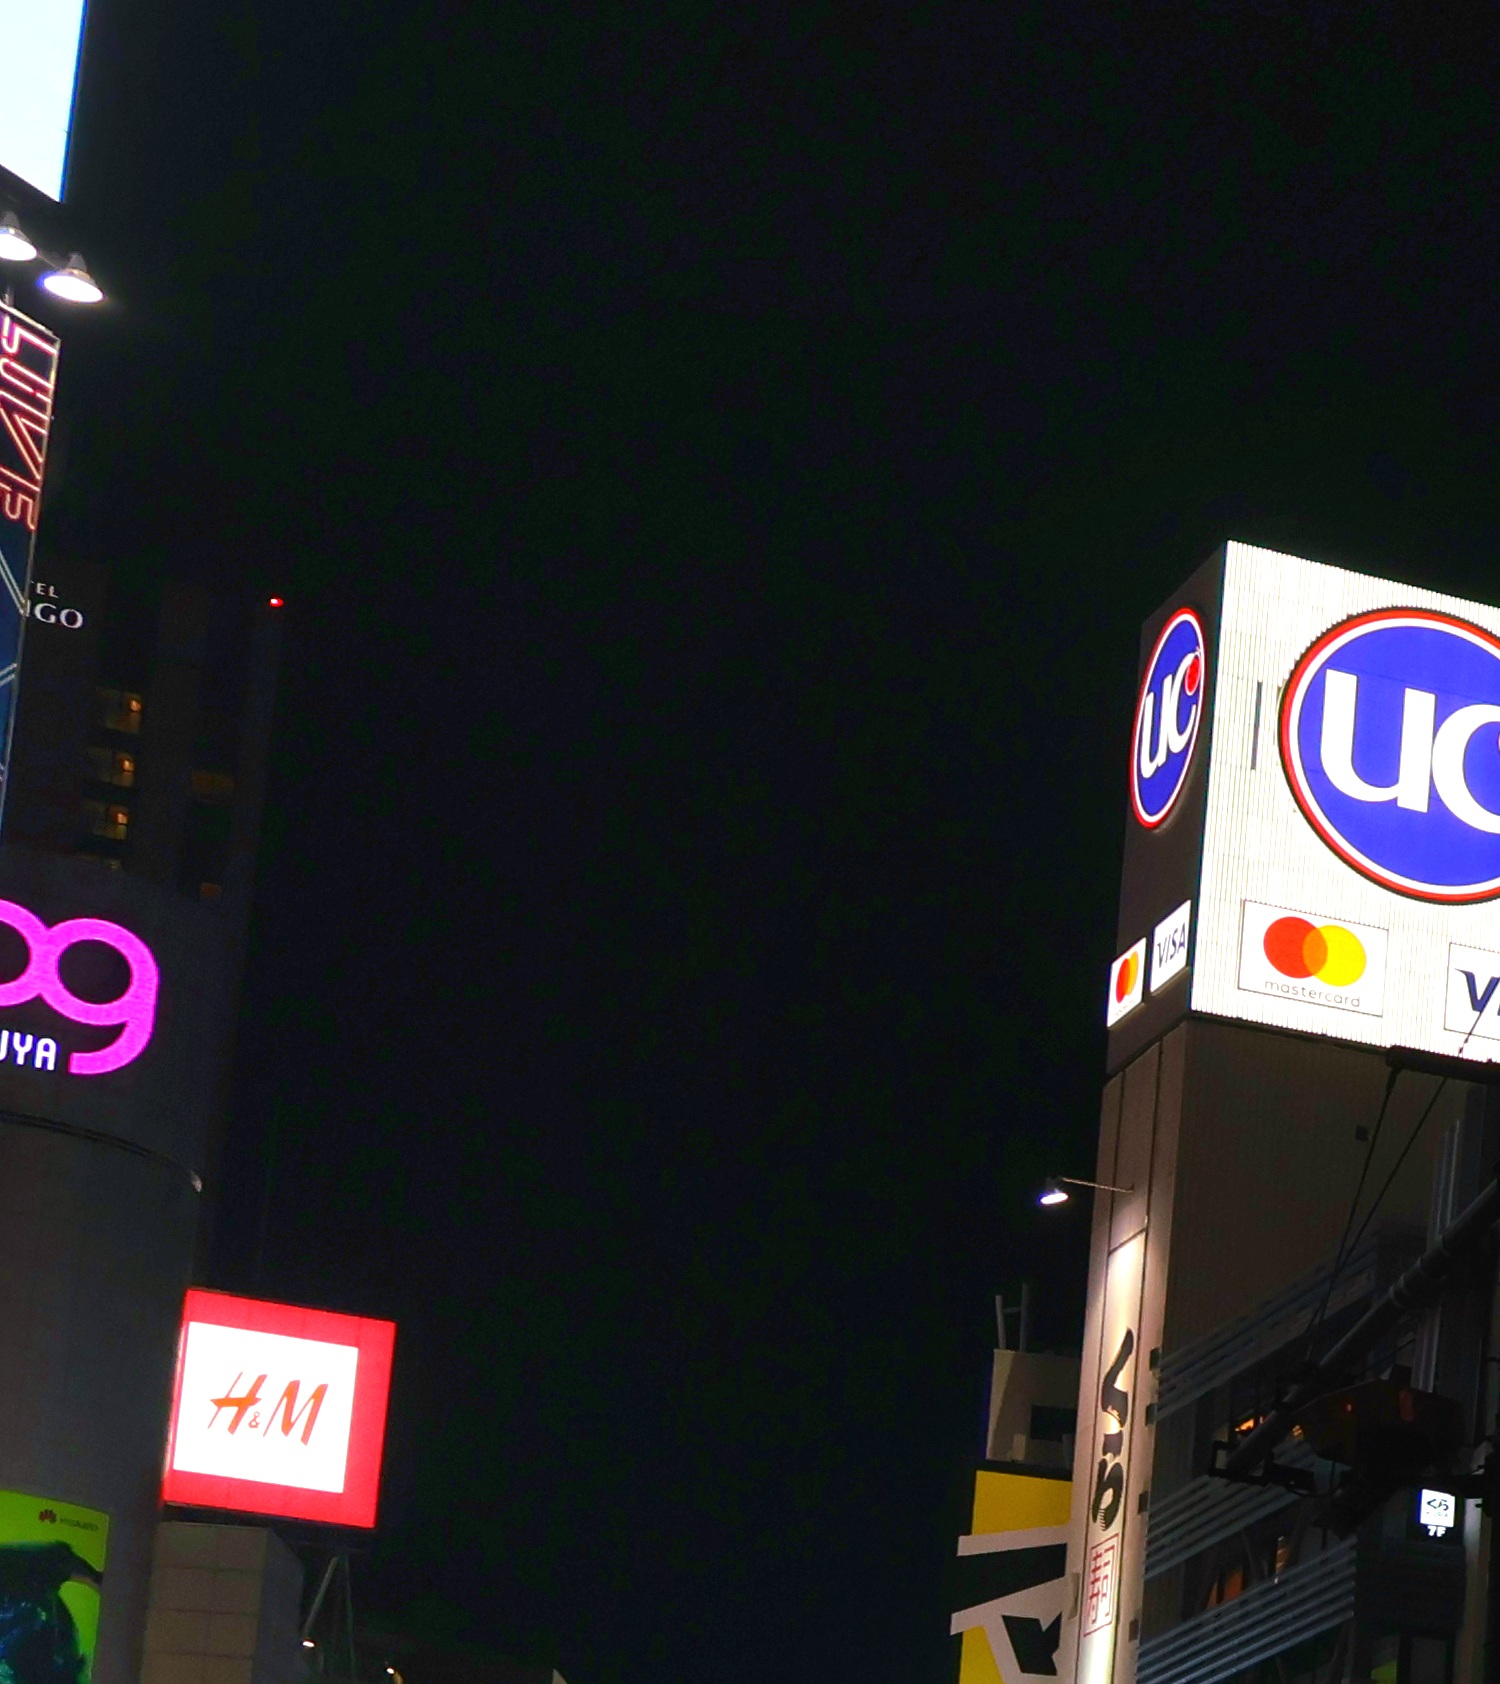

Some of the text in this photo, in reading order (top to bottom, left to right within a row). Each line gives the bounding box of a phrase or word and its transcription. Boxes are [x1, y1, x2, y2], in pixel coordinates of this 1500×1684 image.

[1140, 652, 1198, 778] UC
[1157, 934, 1187, 968] VISA
[1264, 977, 1361, 1009] mastercard
[207, 1371, 329, 1446] H&M
